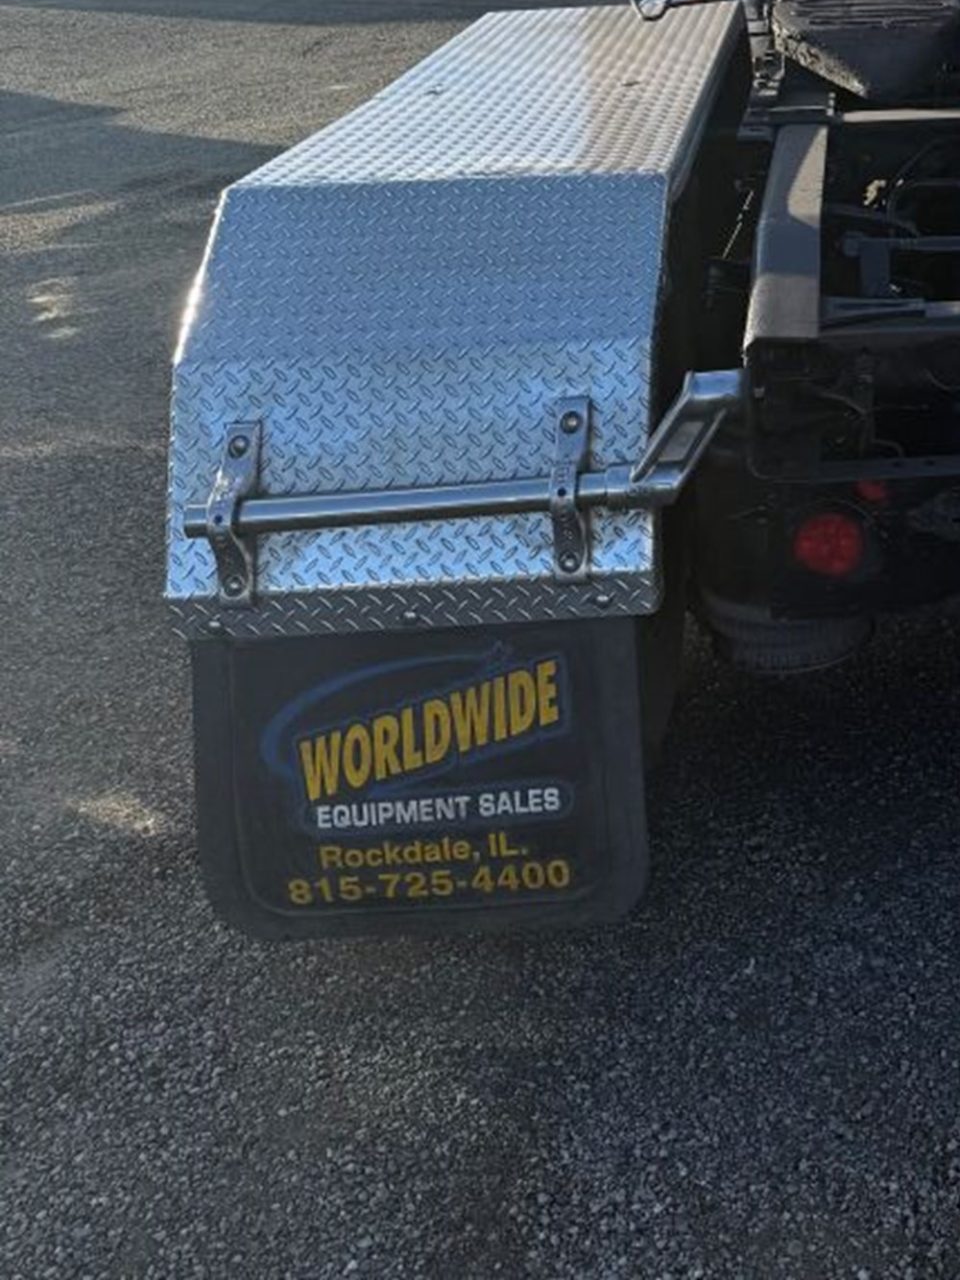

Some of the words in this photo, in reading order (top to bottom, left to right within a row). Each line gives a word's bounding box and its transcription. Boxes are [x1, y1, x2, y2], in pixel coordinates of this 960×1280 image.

[299, 660, 560, 801] WORLDWIDE
[316, 795, 470, 829] EQUIPMENT
[479, 787, 561, 816] SALES
[319, 835, 482, 870] Rockdale,
[488, 832, 528, 858] IL.
[288, 859, 571, 905] 815-725-4400
